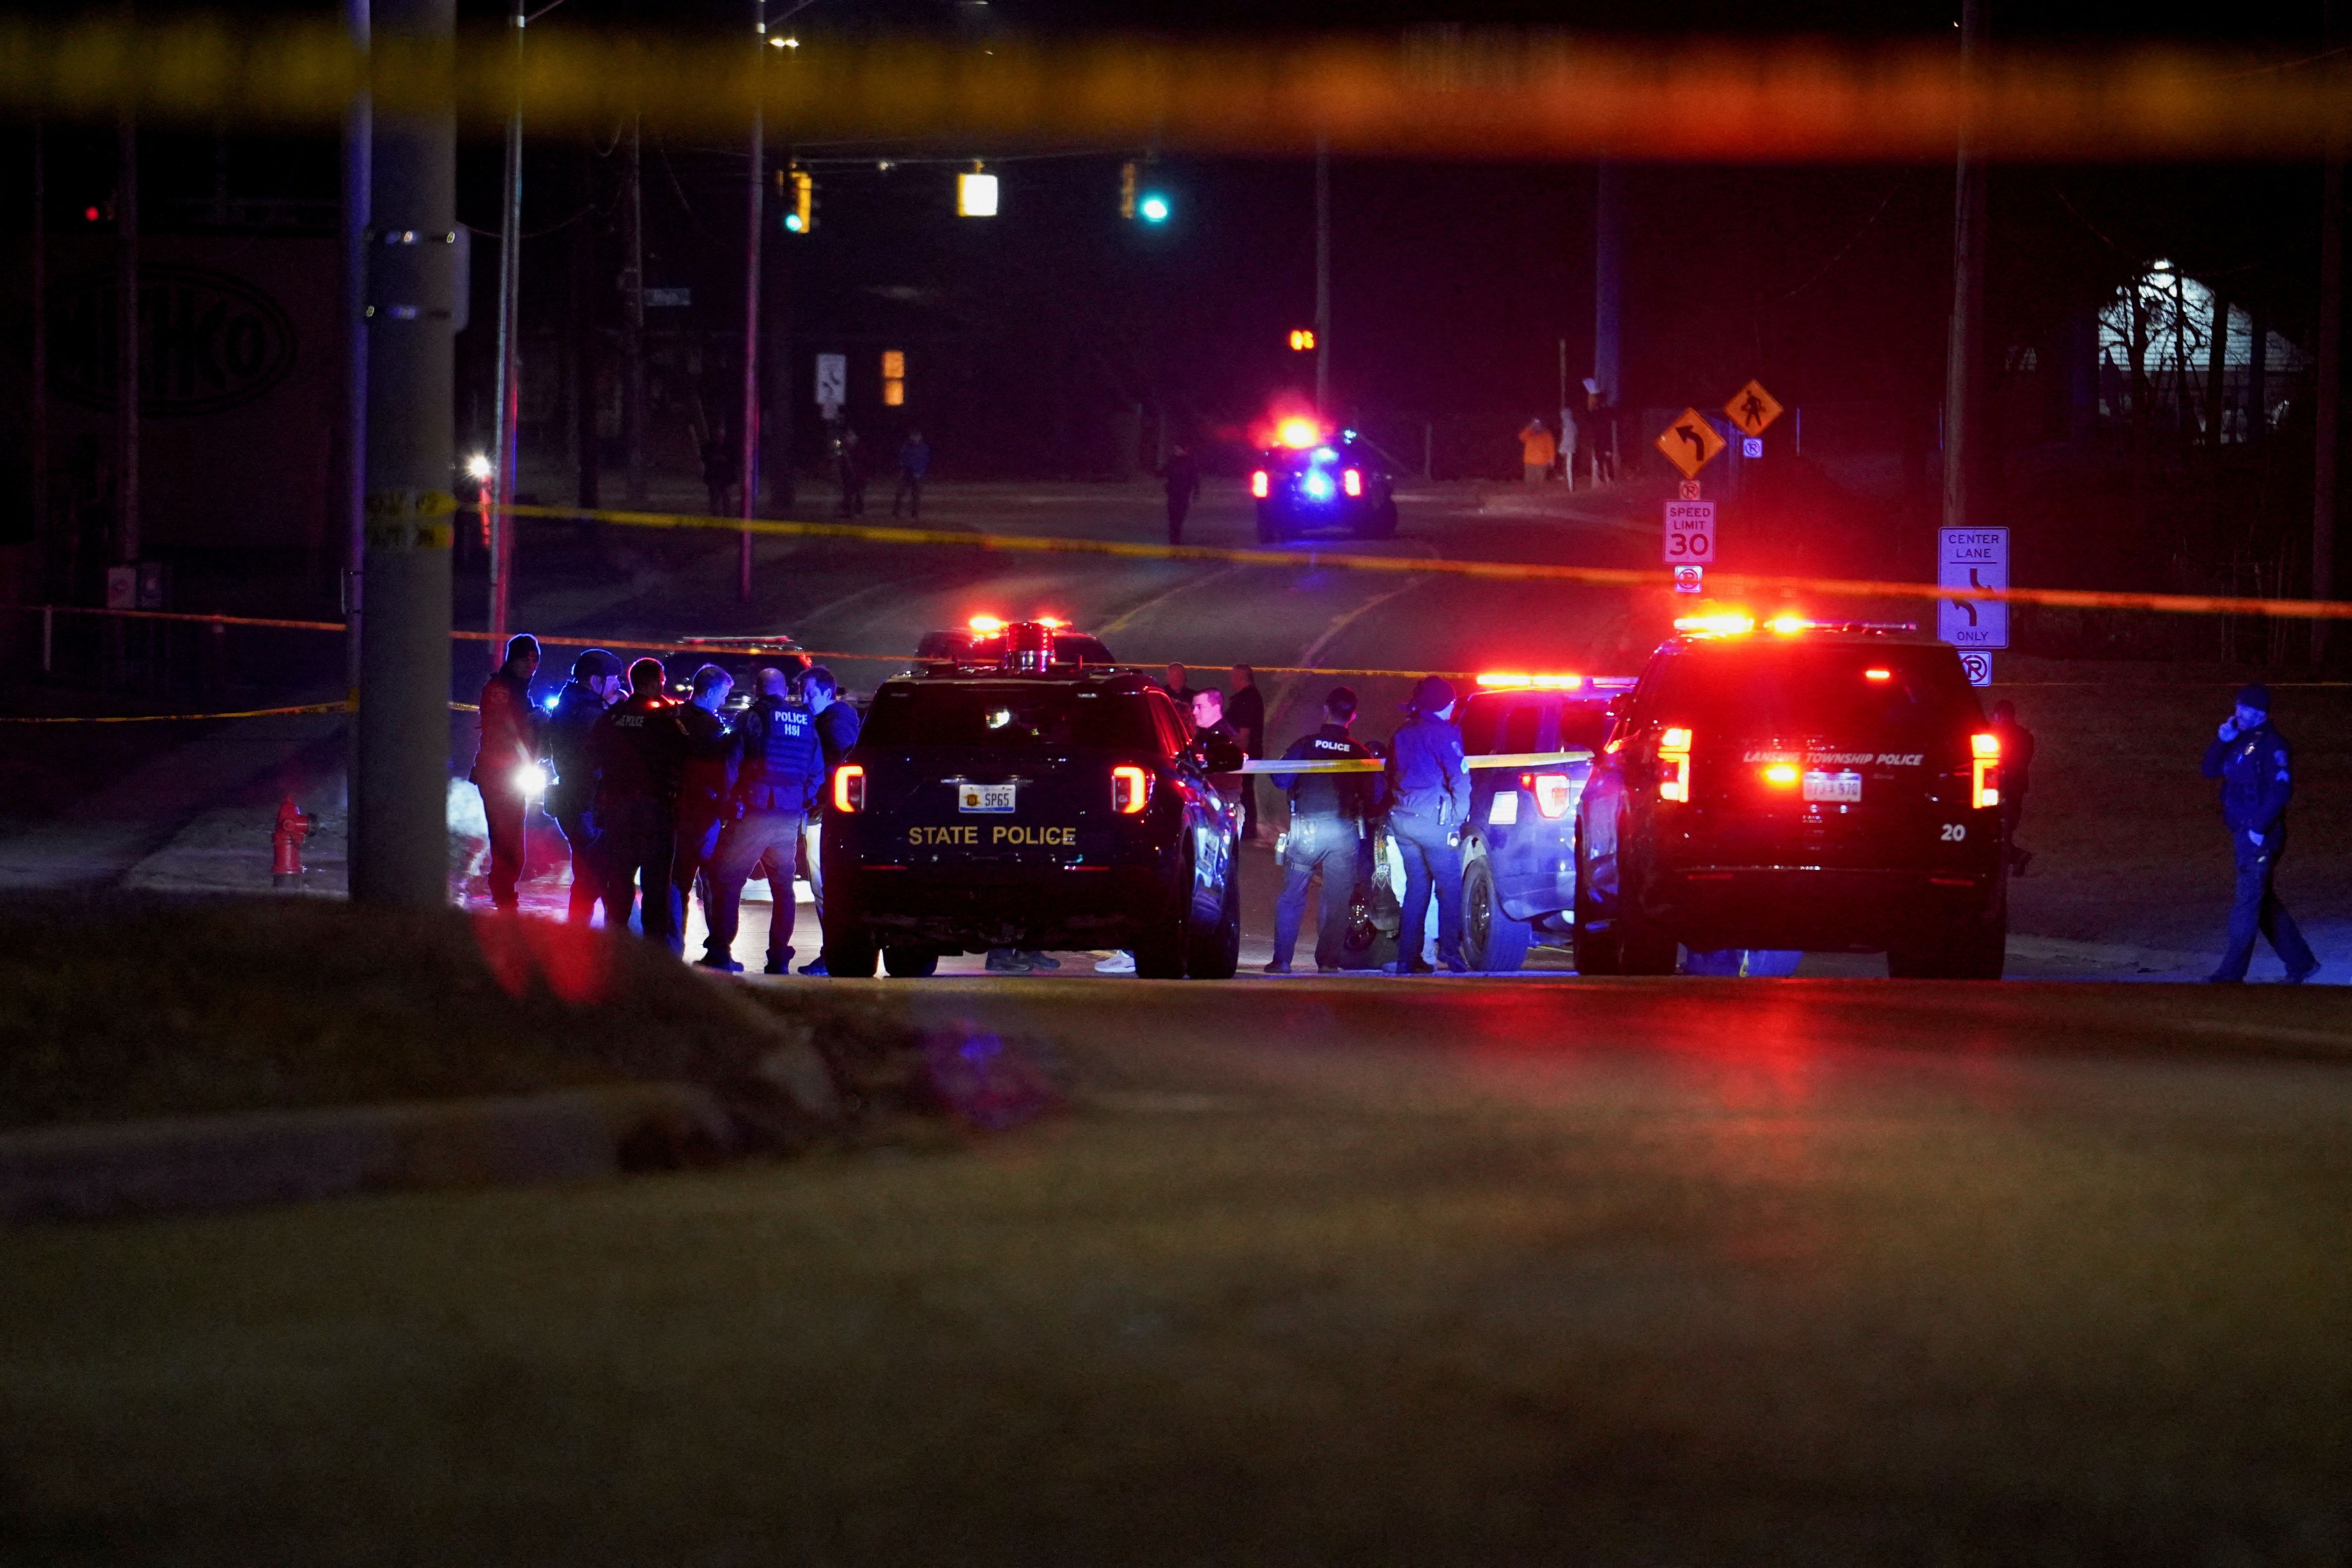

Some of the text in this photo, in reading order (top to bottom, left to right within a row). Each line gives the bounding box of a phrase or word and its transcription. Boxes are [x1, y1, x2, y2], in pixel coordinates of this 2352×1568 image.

[1670, 507, 1711, 517] SPEED
[1673, 520, 1706, 530] LIMIT
[1669, 533, 1709, 556] 30
[1949, 534, 1999, 544] CENTER
[1957, 548, 1991, 558] LANE
[1957, 632, 1989, 641] ONLY
[775, 711, 808, 725] POLICE
[784, 723, 800, 736] HSI
[1315, 739, 1350, 752] POLICE
[1806, 752, 1873, 765] TOWNSHIP
[1876, 754, 1924, 766] POLICE
[985, 793, 1010, 806] SP65
[909, 826, 1076, 846] STATE POLICE
[1941, 823, 1965, 841] 20
